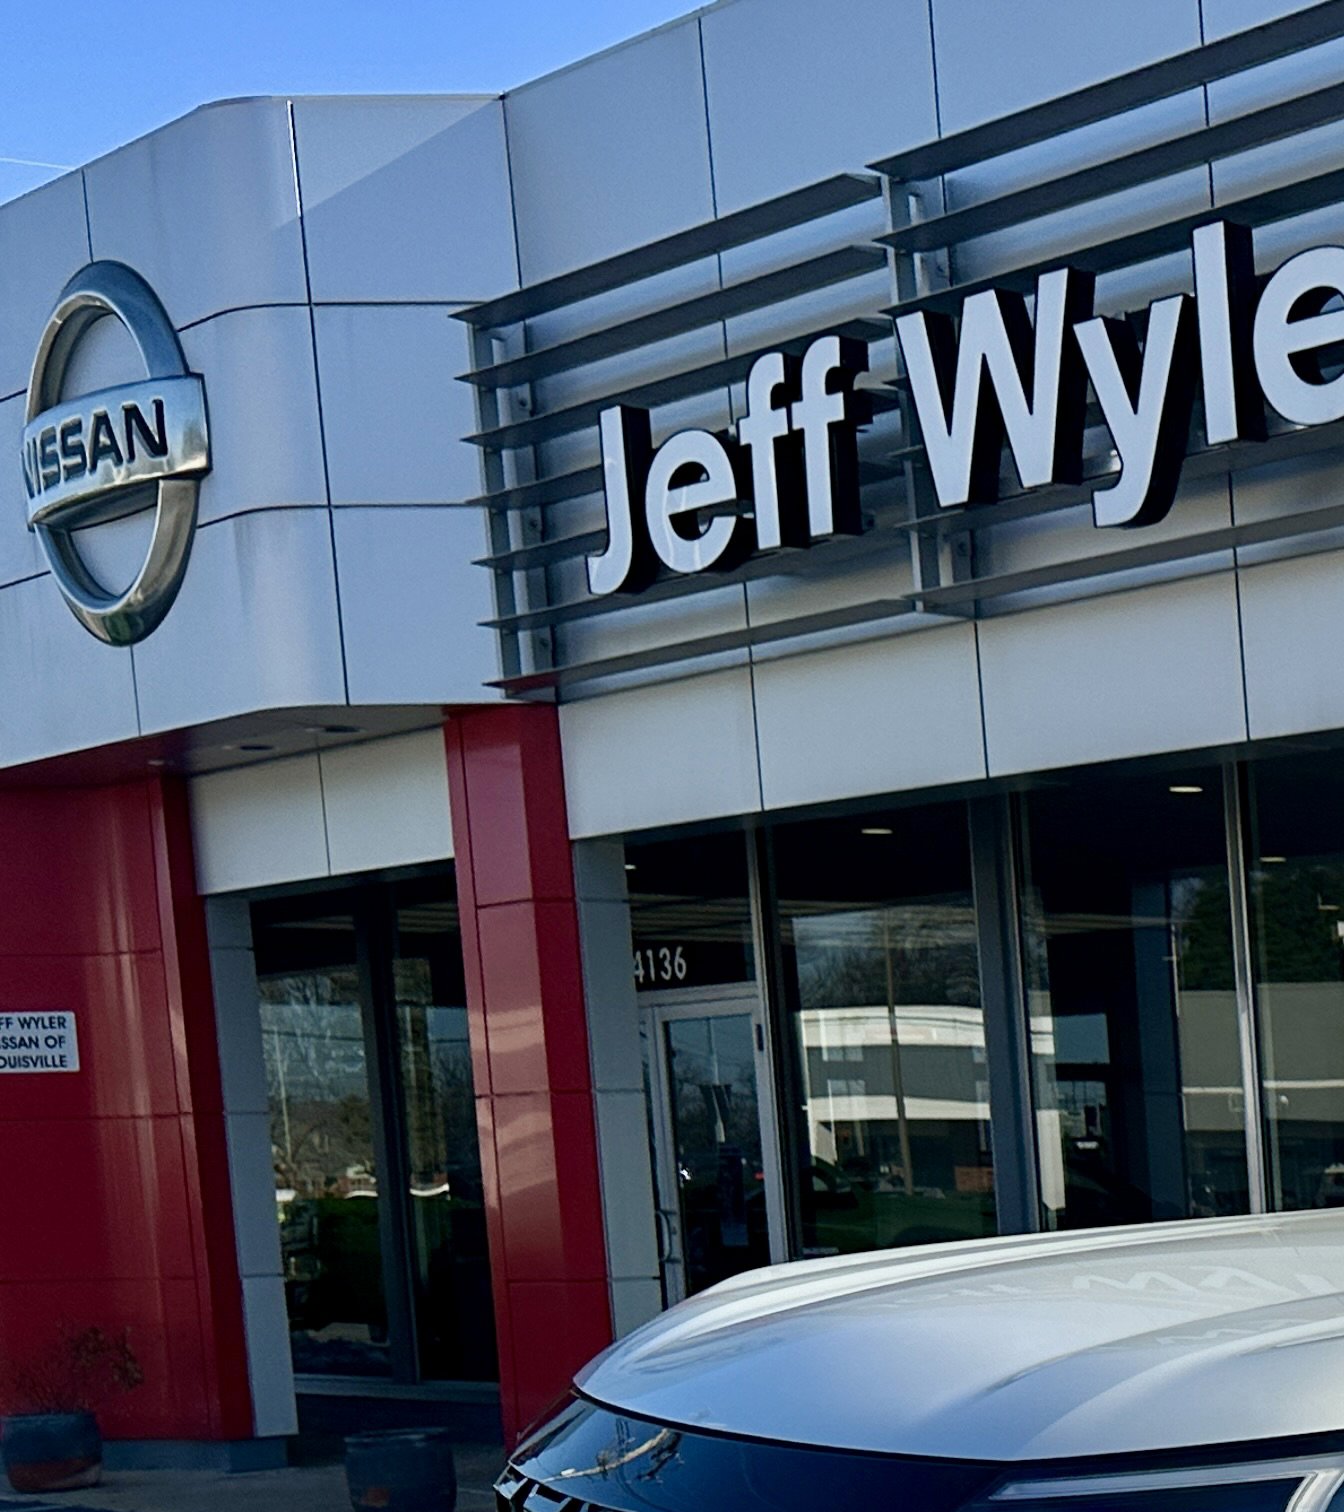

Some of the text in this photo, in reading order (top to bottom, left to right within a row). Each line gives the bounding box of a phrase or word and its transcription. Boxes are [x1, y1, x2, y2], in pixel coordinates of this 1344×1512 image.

[21, 398, 168, 500] NISSAN
[587, 335, 845, 597] Jeff
[634, 946, 687, 983] 4136
[17, 1015, 67, 1029] WYLER
[0, 1034, 66, 1049] SSAN OF
